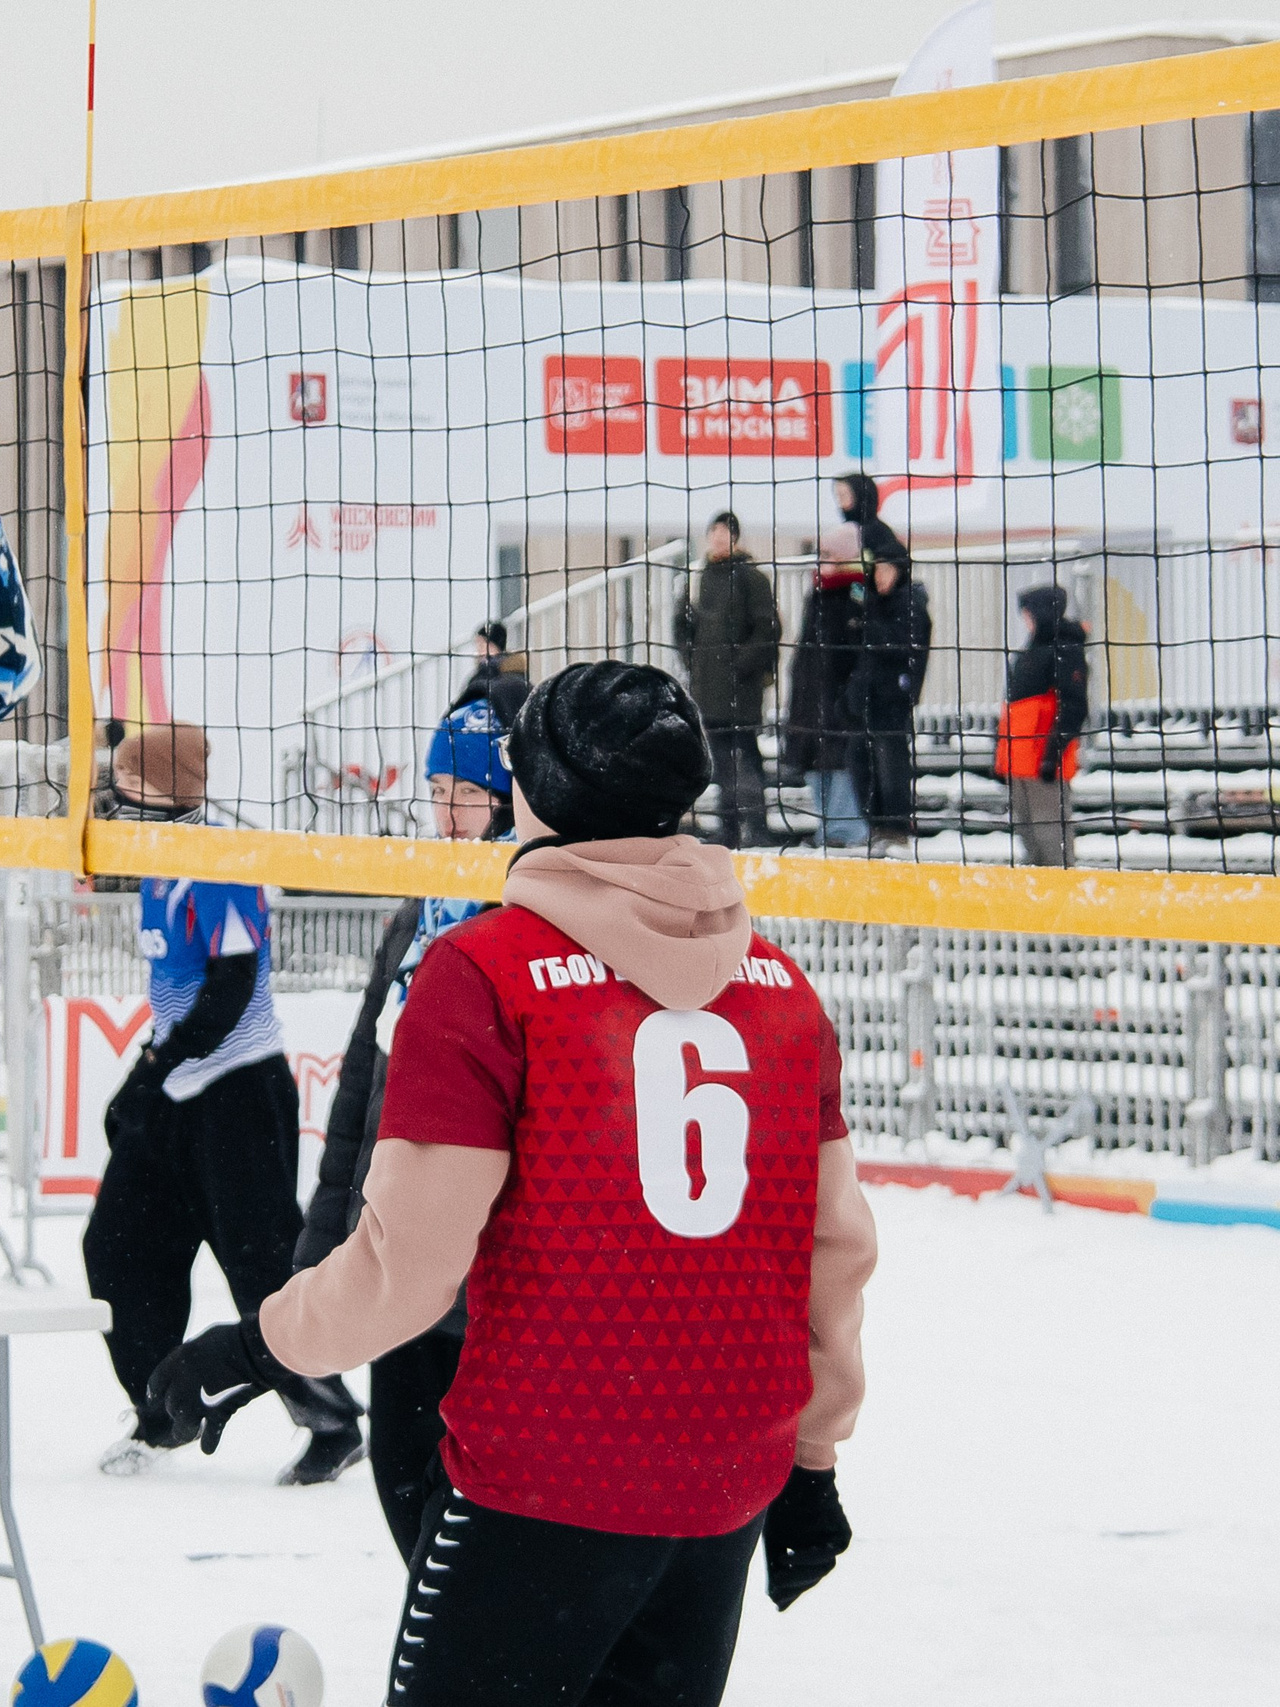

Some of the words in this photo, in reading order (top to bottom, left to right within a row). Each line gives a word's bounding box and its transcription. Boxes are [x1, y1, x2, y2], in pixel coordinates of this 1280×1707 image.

[680, 374, 807, 416] ЗИМА
[703, 416, 809, 441] МОСКВЕ
[633, 1008, 751, 1238] 6
